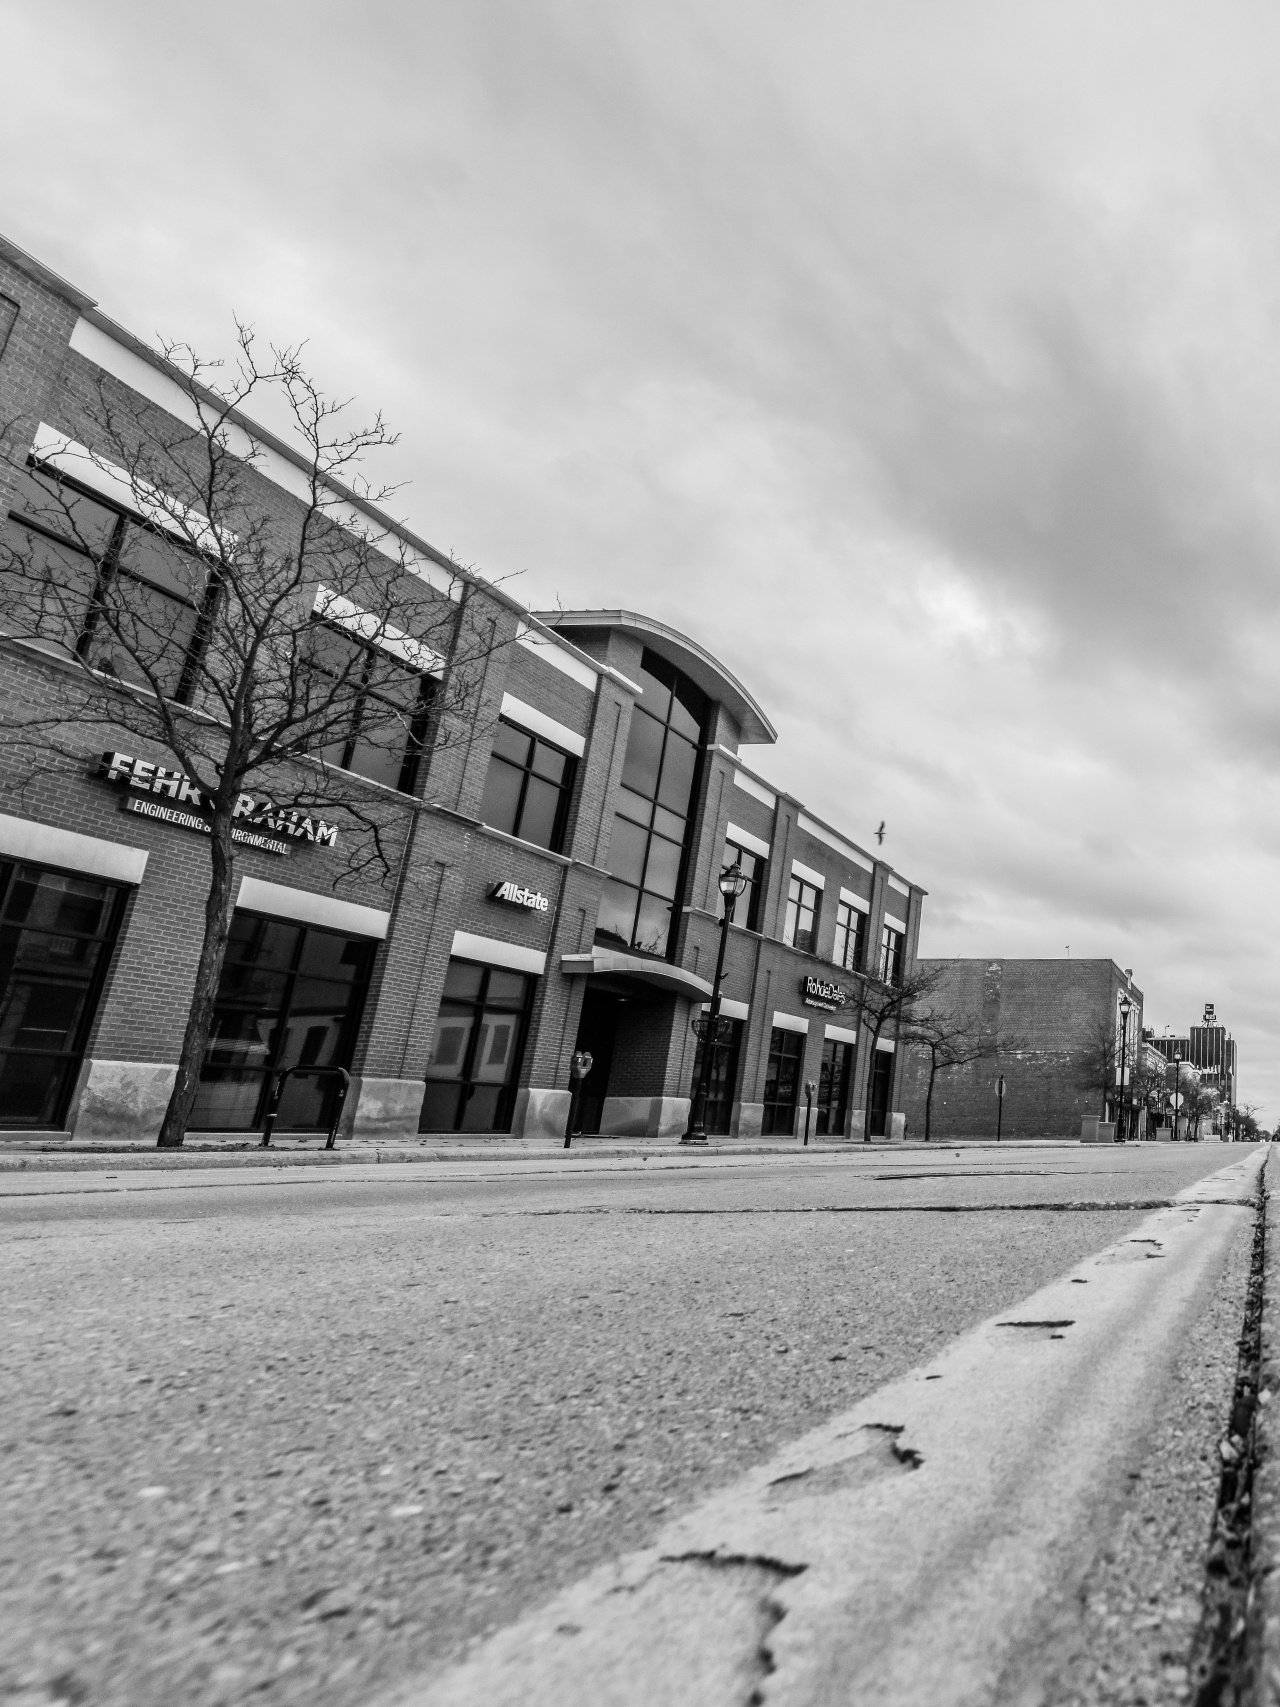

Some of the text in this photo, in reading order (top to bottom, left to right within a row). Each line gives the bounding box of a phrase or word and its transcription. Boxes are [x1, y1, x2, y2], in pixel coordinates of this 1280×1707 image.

[107, 752, 339, 847] FEHR RAHAM
[133, 799, 203, 832] ENGINEERING
[231, 828, 288, 855] IRONMENTAL
[495, 881, 549, 911] Allstate
